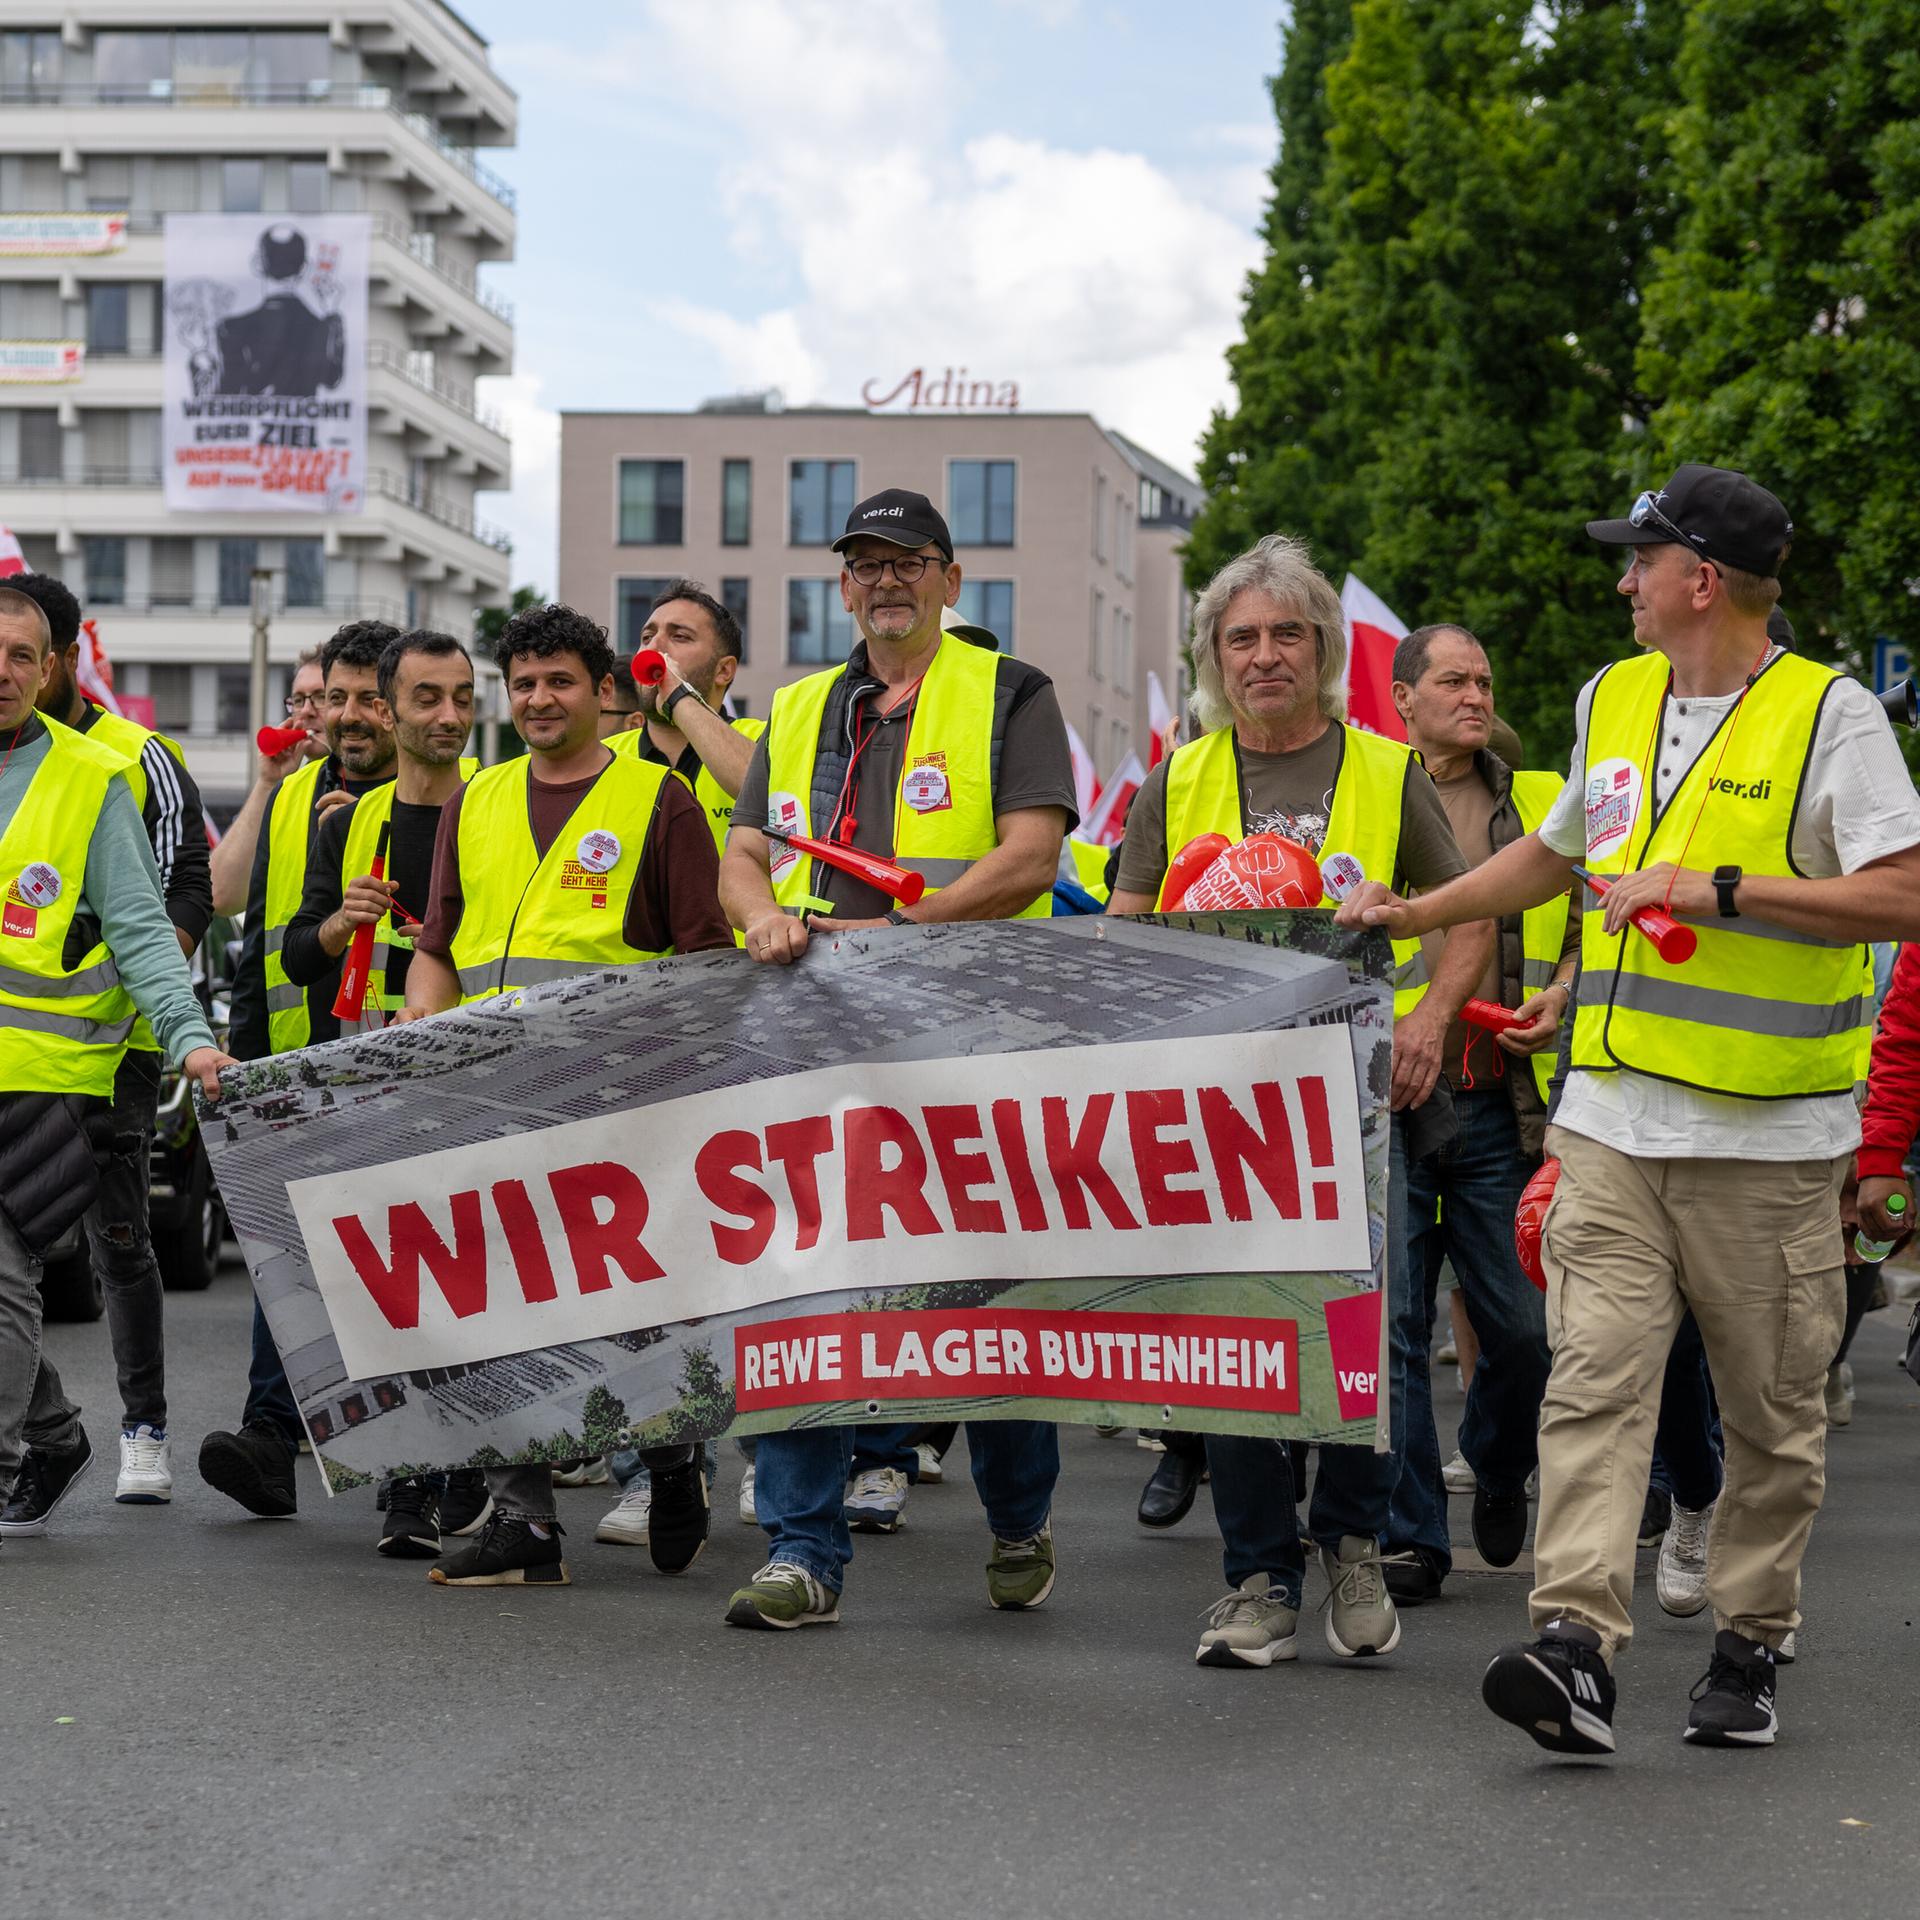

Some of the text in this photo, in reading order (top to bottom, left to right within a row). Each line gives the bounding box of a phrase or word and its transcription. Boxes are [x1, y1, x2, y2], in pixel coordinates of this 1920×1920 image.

[862, 367, 1020, 407] Adina
[259, 422, 318, 447] ZIEL
[863, 507, 904, 519] ver.di
[1709, 777, 1772, 799] ver.di
[561, 875, 608, 887] GEHT MEHR
[4, 920, 34, 936] ver.di
[332, 1076, 1339, 1329] WIR STREIKEN!
[744, 1329, 1286, 1391] REWE LAGER BUTTENHEIM
